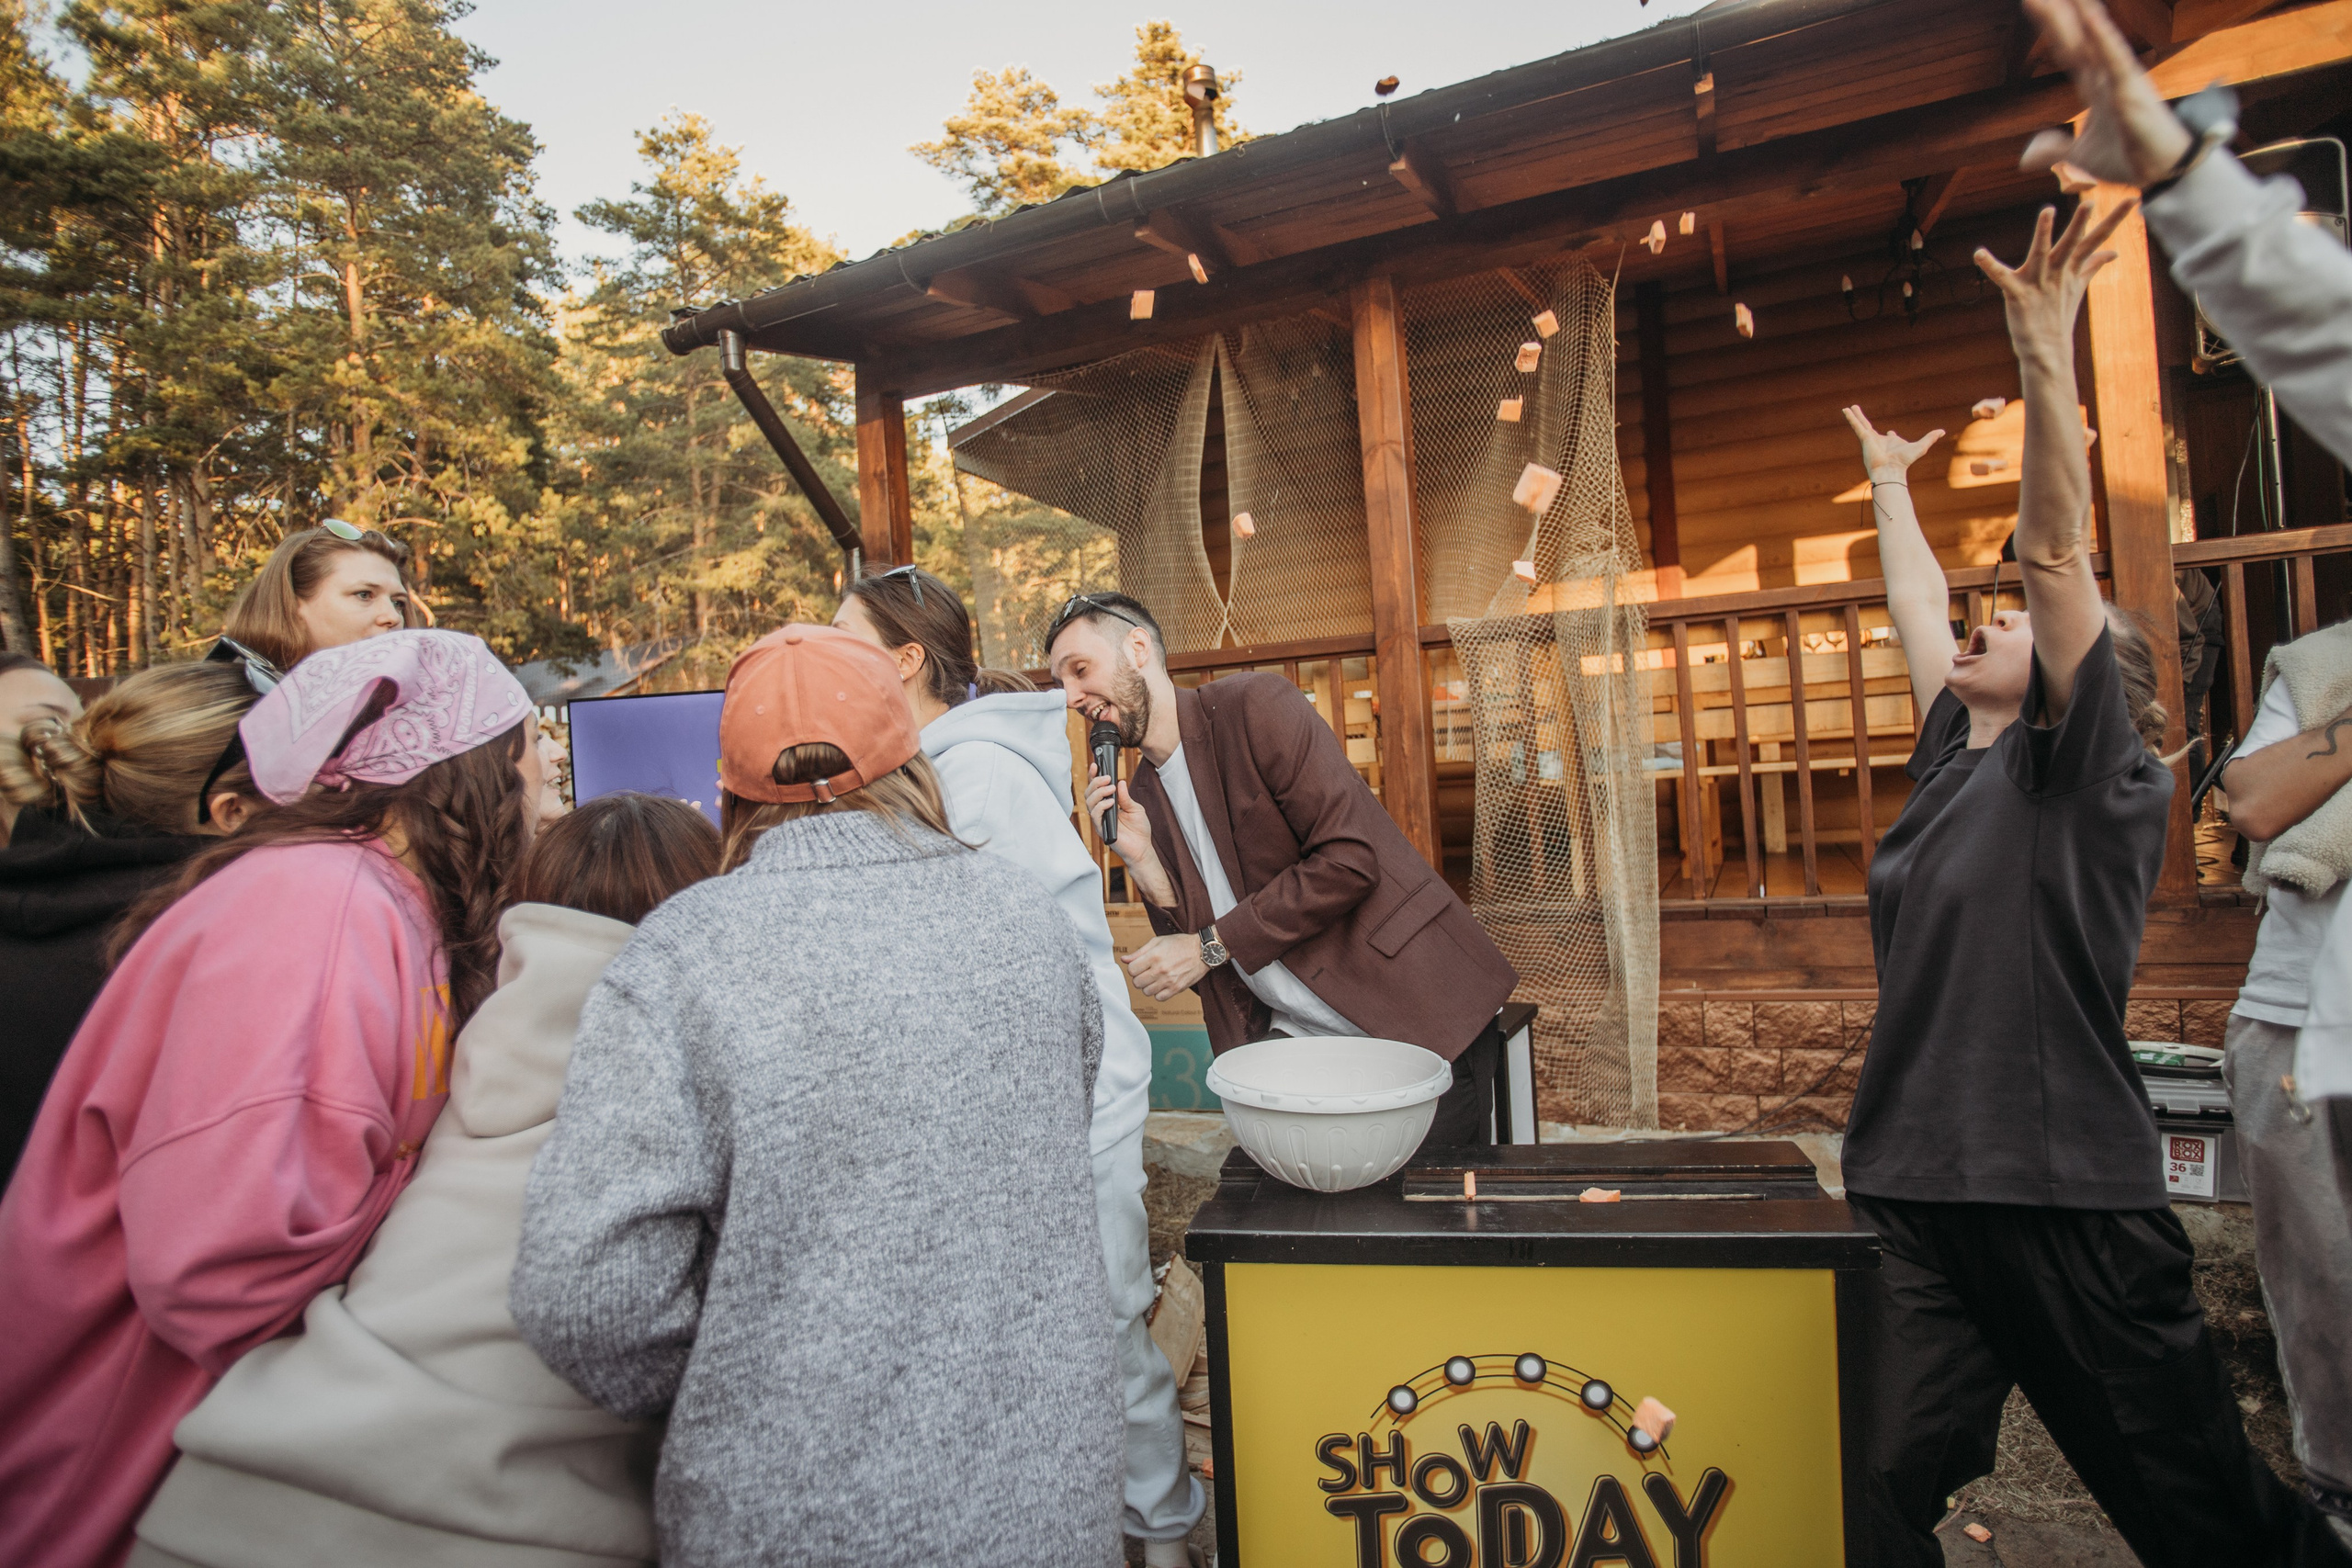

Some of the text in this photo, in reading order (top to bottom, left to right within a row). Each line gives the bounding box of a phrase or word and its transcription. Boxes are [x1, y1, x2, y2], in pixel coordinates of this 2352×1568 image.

[2172, 1140, 2201, 1150] ROX
[2172, 1148, 2201, 1159] BOX
[2169, 1162, 2187, 1173] 36
[1315, 1418, 1530, 1508] SHOW
[1324, 1466, 1728, 1568] TODAY
